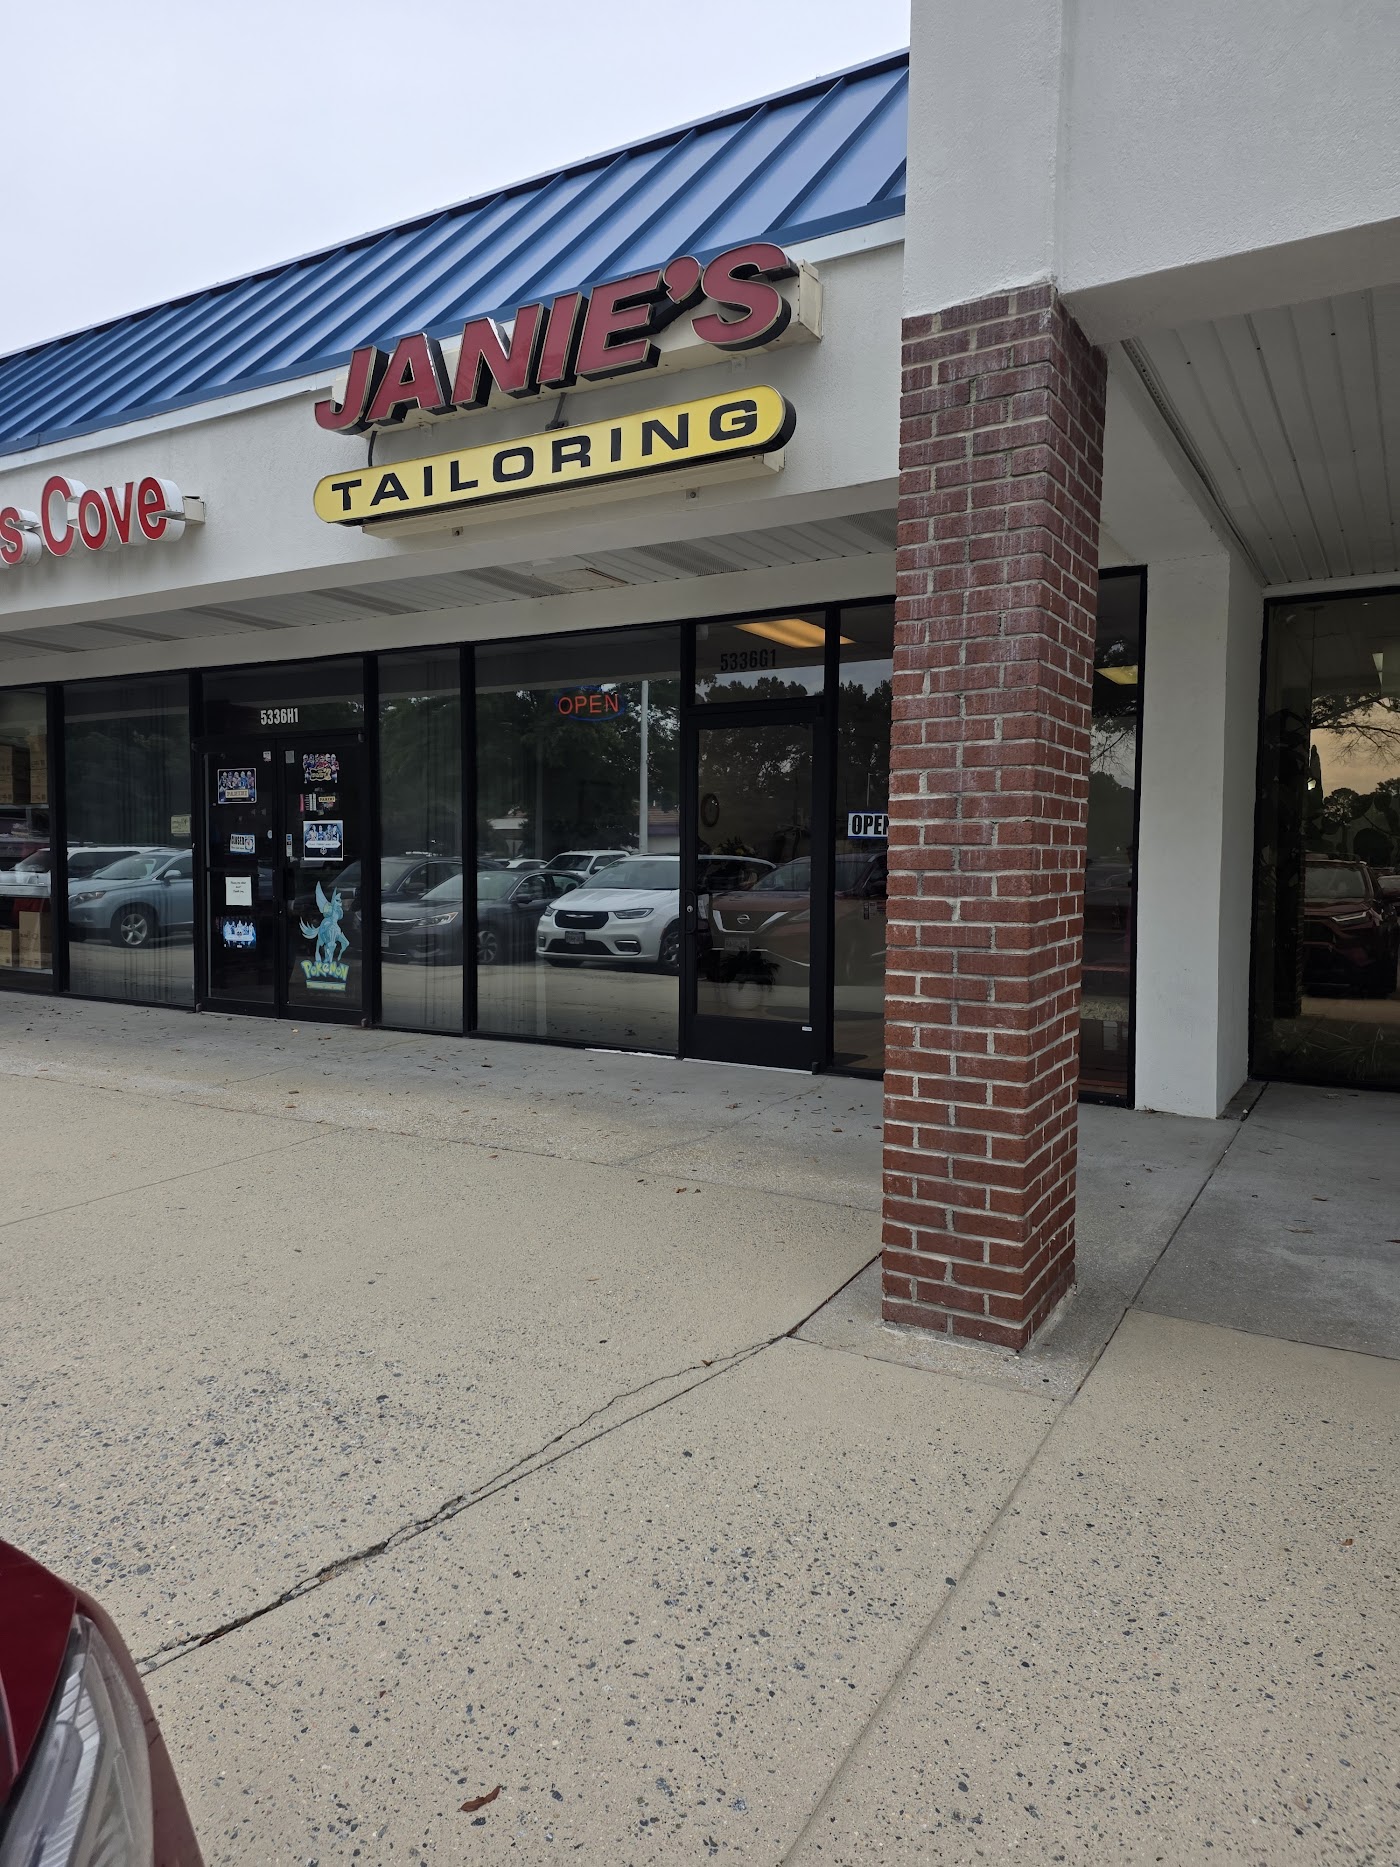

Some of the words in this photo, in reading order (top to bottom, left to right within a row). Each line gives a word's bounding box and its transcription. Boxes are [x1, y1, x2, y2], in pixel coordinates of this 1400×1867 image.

[314, 243, 795, 433] JANIE'S
[331, 399, 758, 512] TAILORING
[41, 475, 168, 557] Cove
[720, 649, 777, 671] 5336G1
[260, 707, 299, 725] 5336H1
[557, 694, 620, 715] OPEN
